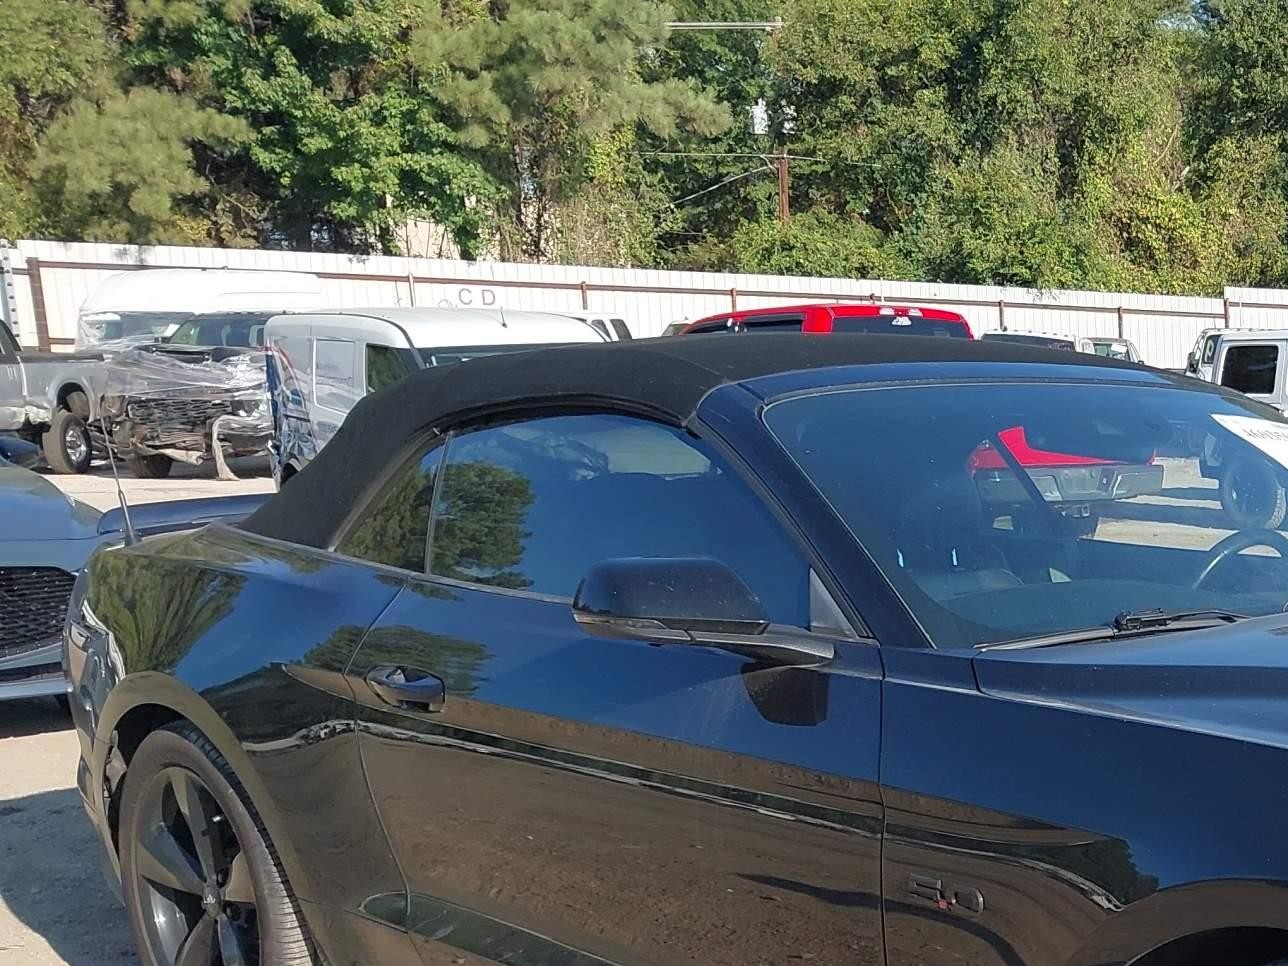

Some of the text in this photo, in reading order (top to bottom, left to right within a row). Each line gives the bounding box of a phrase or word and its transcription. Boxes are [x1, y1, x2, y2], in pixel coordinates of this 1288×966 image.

[458, 288, 496, 306] C D
[908, 873, 986, 917] 5.0
